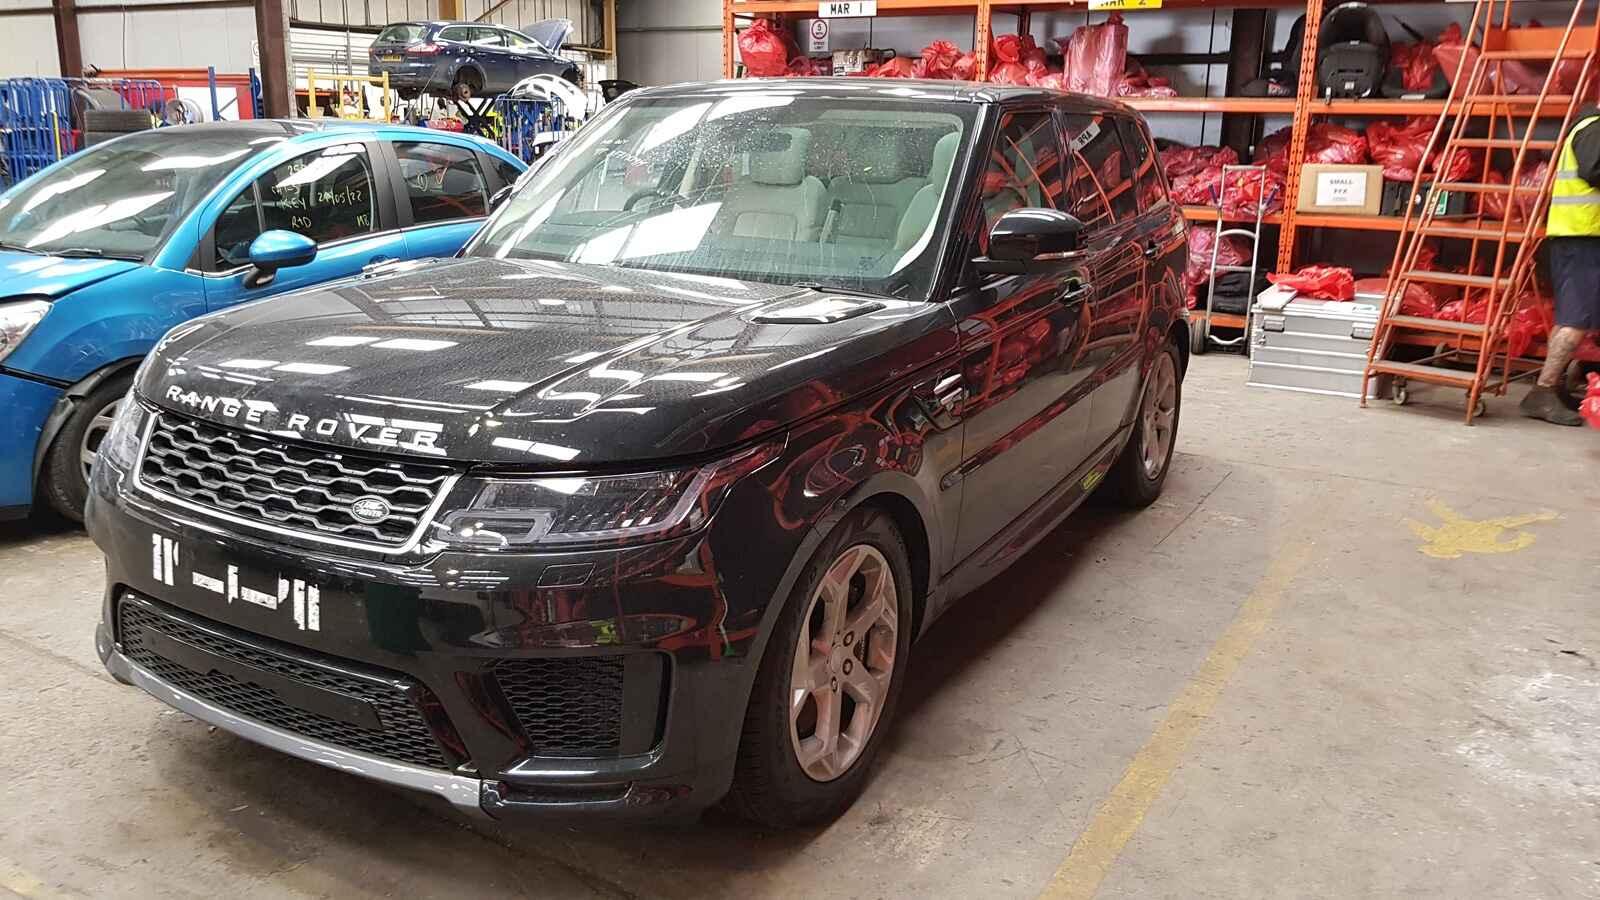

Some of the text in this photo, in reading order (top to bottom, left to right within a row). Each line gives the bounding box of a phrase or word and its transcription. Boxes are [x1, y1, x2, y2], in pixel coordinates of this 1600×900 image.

[830, 3, 850, 15] MAR
[165, 385, 439, 449] RANGE ROVER
